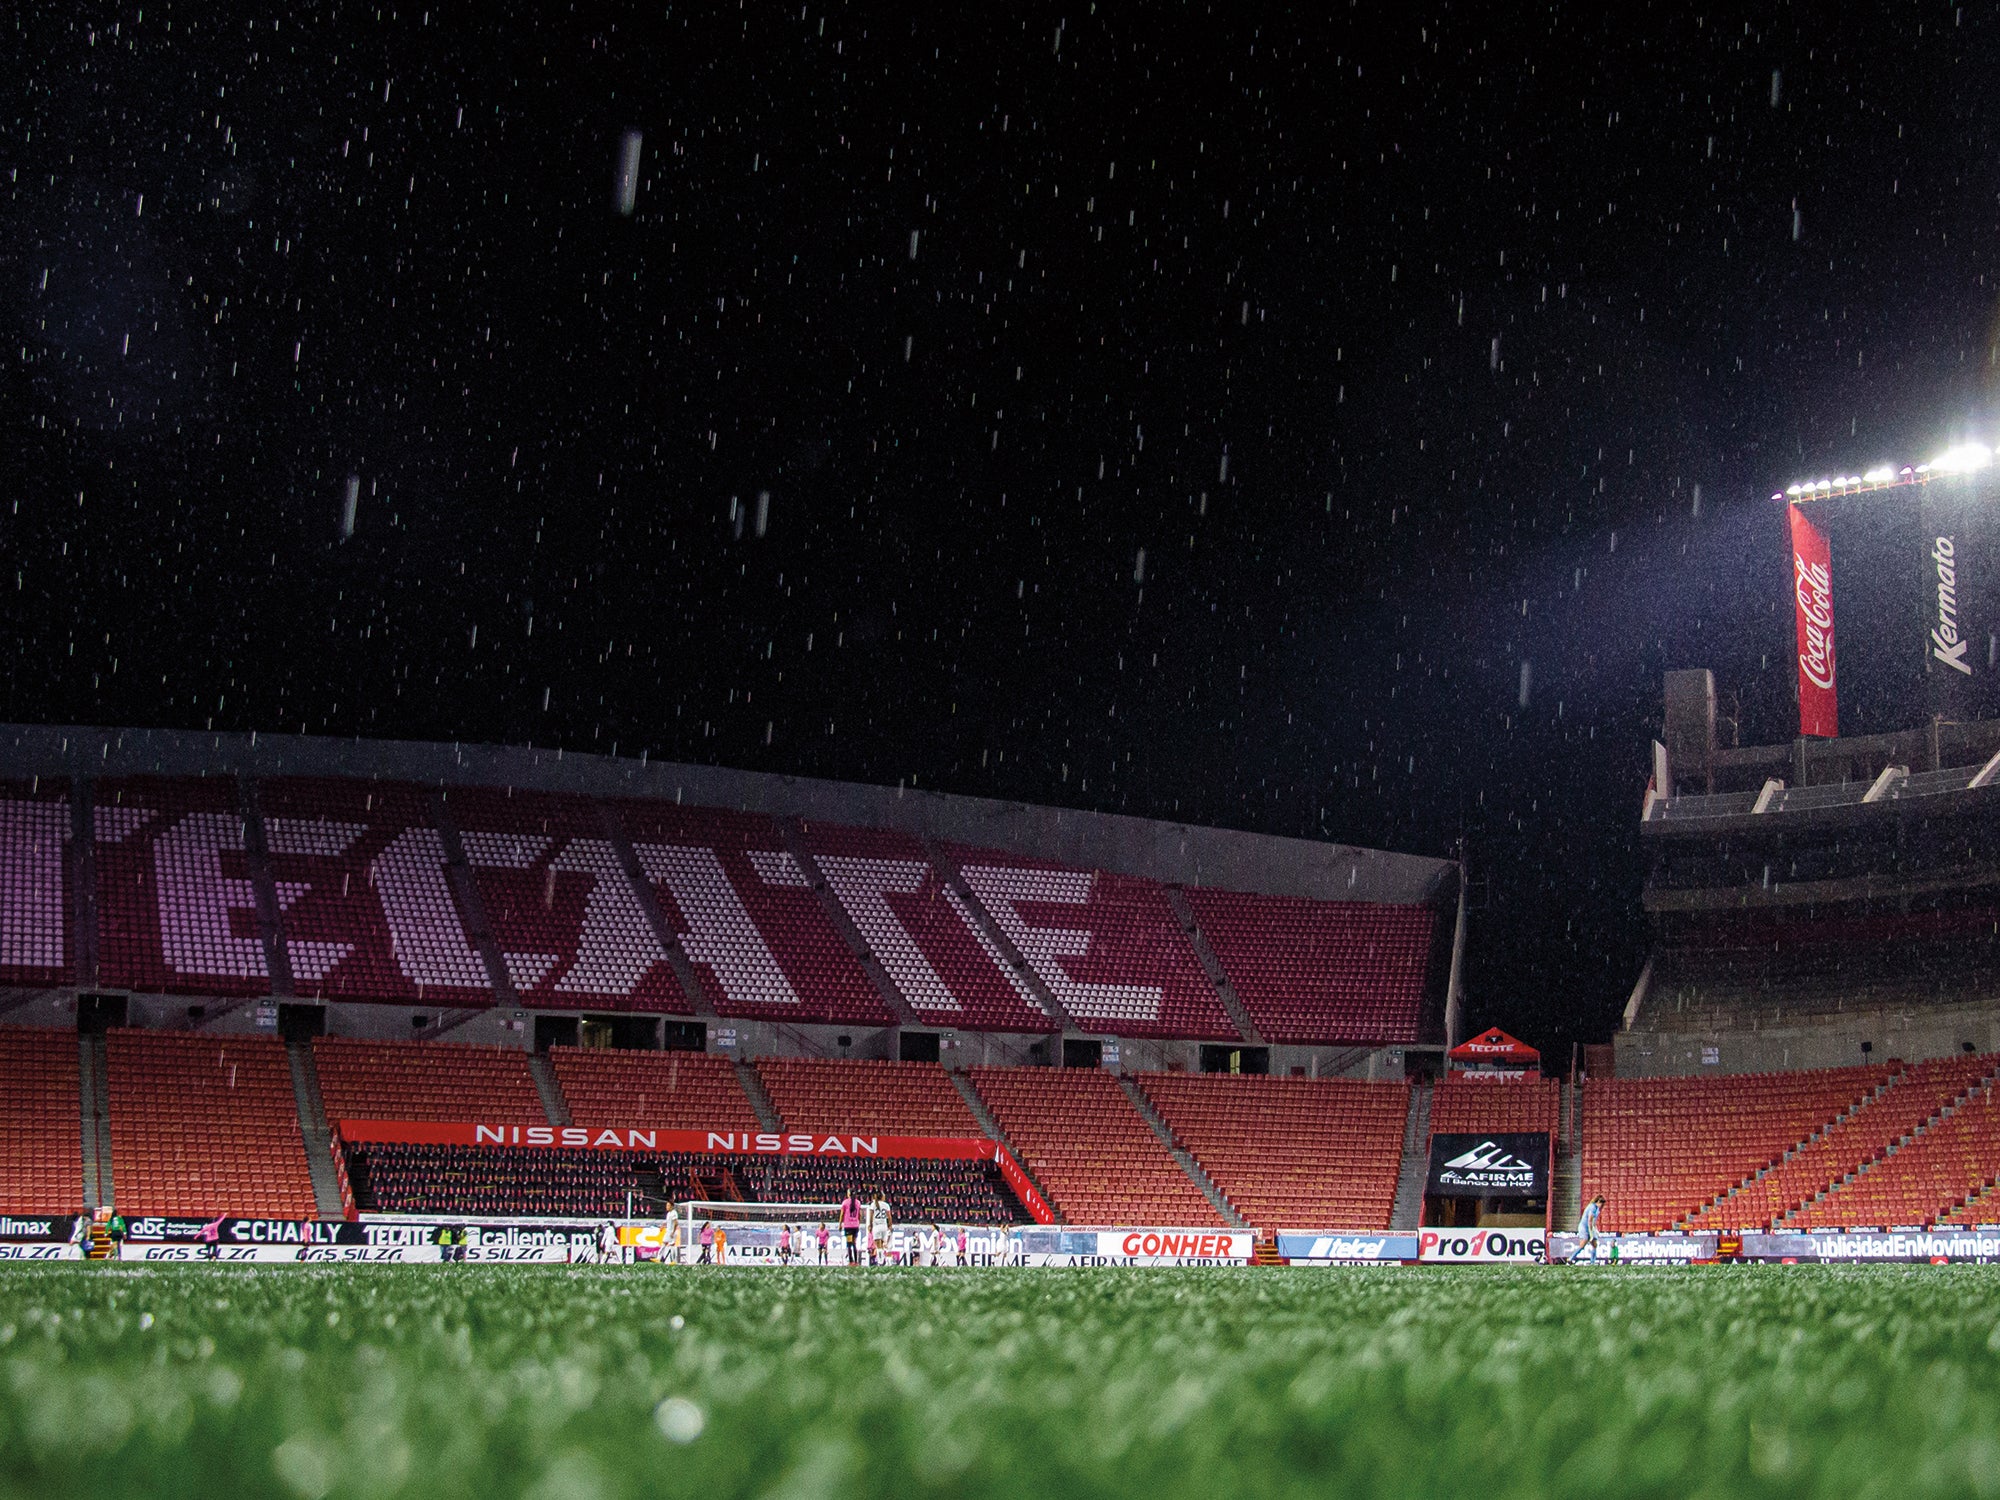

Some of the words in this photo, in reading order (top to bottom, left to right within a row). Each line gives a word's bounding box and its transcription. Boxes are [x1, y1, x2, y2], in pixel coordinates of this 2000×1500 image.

[1931, 536, 1971, 675] Kermato
[0, 800, 1163, 1020] TECATE
[1468, 1043, 1515, 1052] TECATE
[476, 1125, 656, 1148] NISSAN
[707, 1132, 878, 1153] NISSAN
[1453, 1178, 1489, 1186] Banco
[1465, 1172, 1533, 1181] AFIRME
[131, 1217, 165, 1235] abc
[362, 1225, 438, 1245] TECATE
[1122, 1233, 1233, 1257] GONHER
[1329, 1237, 1386, 1259] telcel
[1419, 1230, 1546, 1257] Pro1One
